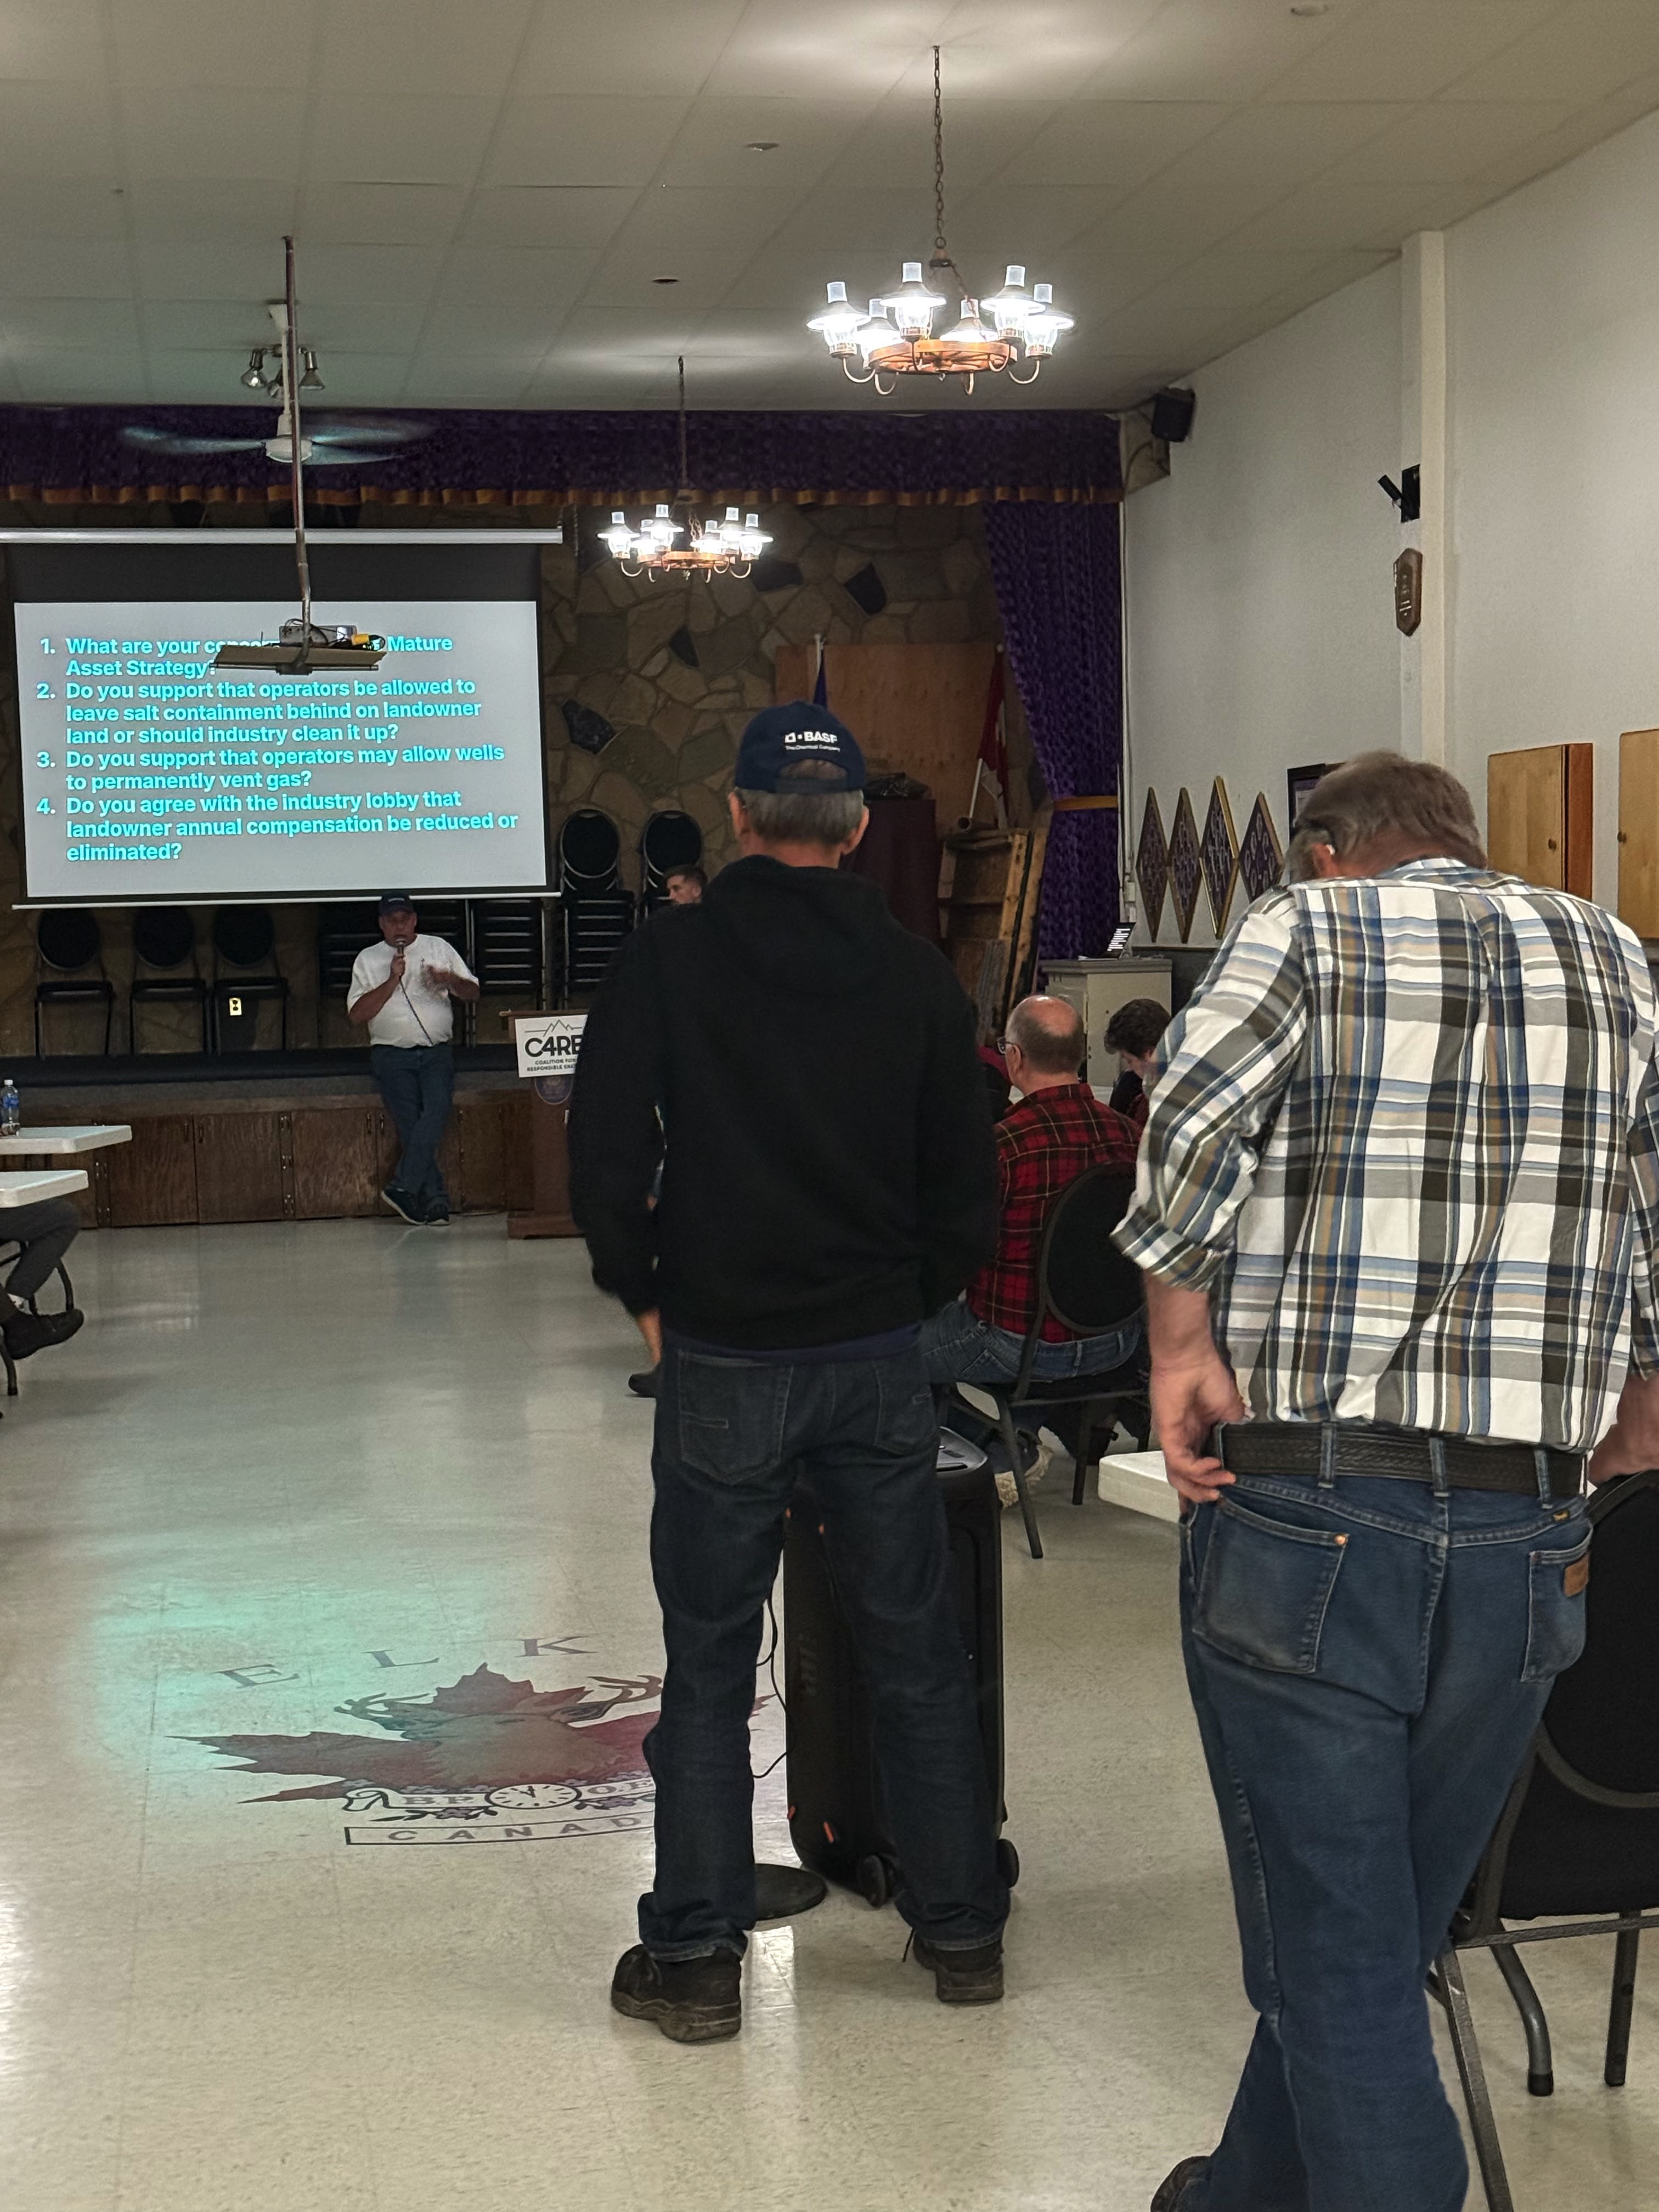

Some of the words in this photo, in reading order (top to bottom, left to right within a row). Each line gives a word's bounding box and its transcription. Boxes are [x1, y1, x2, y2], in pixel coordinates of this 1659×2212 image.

[41, 638, 55, 654] 1.
[65, 638, 118, 654] What
[122, 641, 153, 654] are
[156, 641, 201, 657] your
[387, 635, 453, 652] Mature
[66, 660, 123, 676] Asset
[36, 683, 55, 699] 2.
[66, 682, 93, 698] Do
[97, 685, 134, 702] you
[138, 684, 214, 702] support
[217, 681, 255, 698] that
[259, 681, 350, 701] operators
[354, 680, 377, 696] be
[381, 678, 453, 695] allowed
[456, 679, 476, 694] to
[66, 705, 119, 721] leave
[123, 704, 160, 721] salt
[163, 703, 284, 720] containment
[286, 702, 352, 719] behind
[356, 705, 380, 718] on
[383, 701, 482, 718] landowner
[66, 727, 109, 744] land
[114, 730, 135, 743] or
[138, 726, 204, 743] should
[208, 726, 288, 746] industry
[292, 725, 343, 741] clean
[347, 724, 360, 740] it
[364, 724, 399, 744] up?
[804, 731, 837, 743] BASF
[36, 751, 55, 768] 3.
[66, 751, 94, 768] Do
[98, 753, 135, 771] you
[139, 751, 216, 770] support
[219, 749, 258, 766] that
[262, 748, 354, 769] operators
[358, 749, 398, 766] may
[402, 746, 452, 762] allow
[455, 744, 505, 761] wells
[65, 775, 87, 790] to
[91, 772, 216, 794] permanently
[219, 772, 263, 788] vent
[266, 770, 312, 791] gas?
[36, 798, 56, 814] 4.
[67, 797, 94, 814] Do
[98, 799, 136, 817] you
[140, 799, 196, 816] agree
[199, 794, 242, 812] with
[245, 794, 278, 811] the
[282, 793, 362, 812] industry
[366, 792, 419, 812] lobby
[422, 791, 462, 807] that
[67, 820, 173, 838] landowner
[176, 818, 242, 836] annual
[246, 815, 383, 838] compensation
[387, 815, 411, 832] be
[415, 812, 494, 831] reduced
[498, 815, 518, 828] or
[66, 842, 182, 861] eliminated?
[214, 1633, 600, 1689] ELK
[387, 1816, 642, 1841] CANAD
